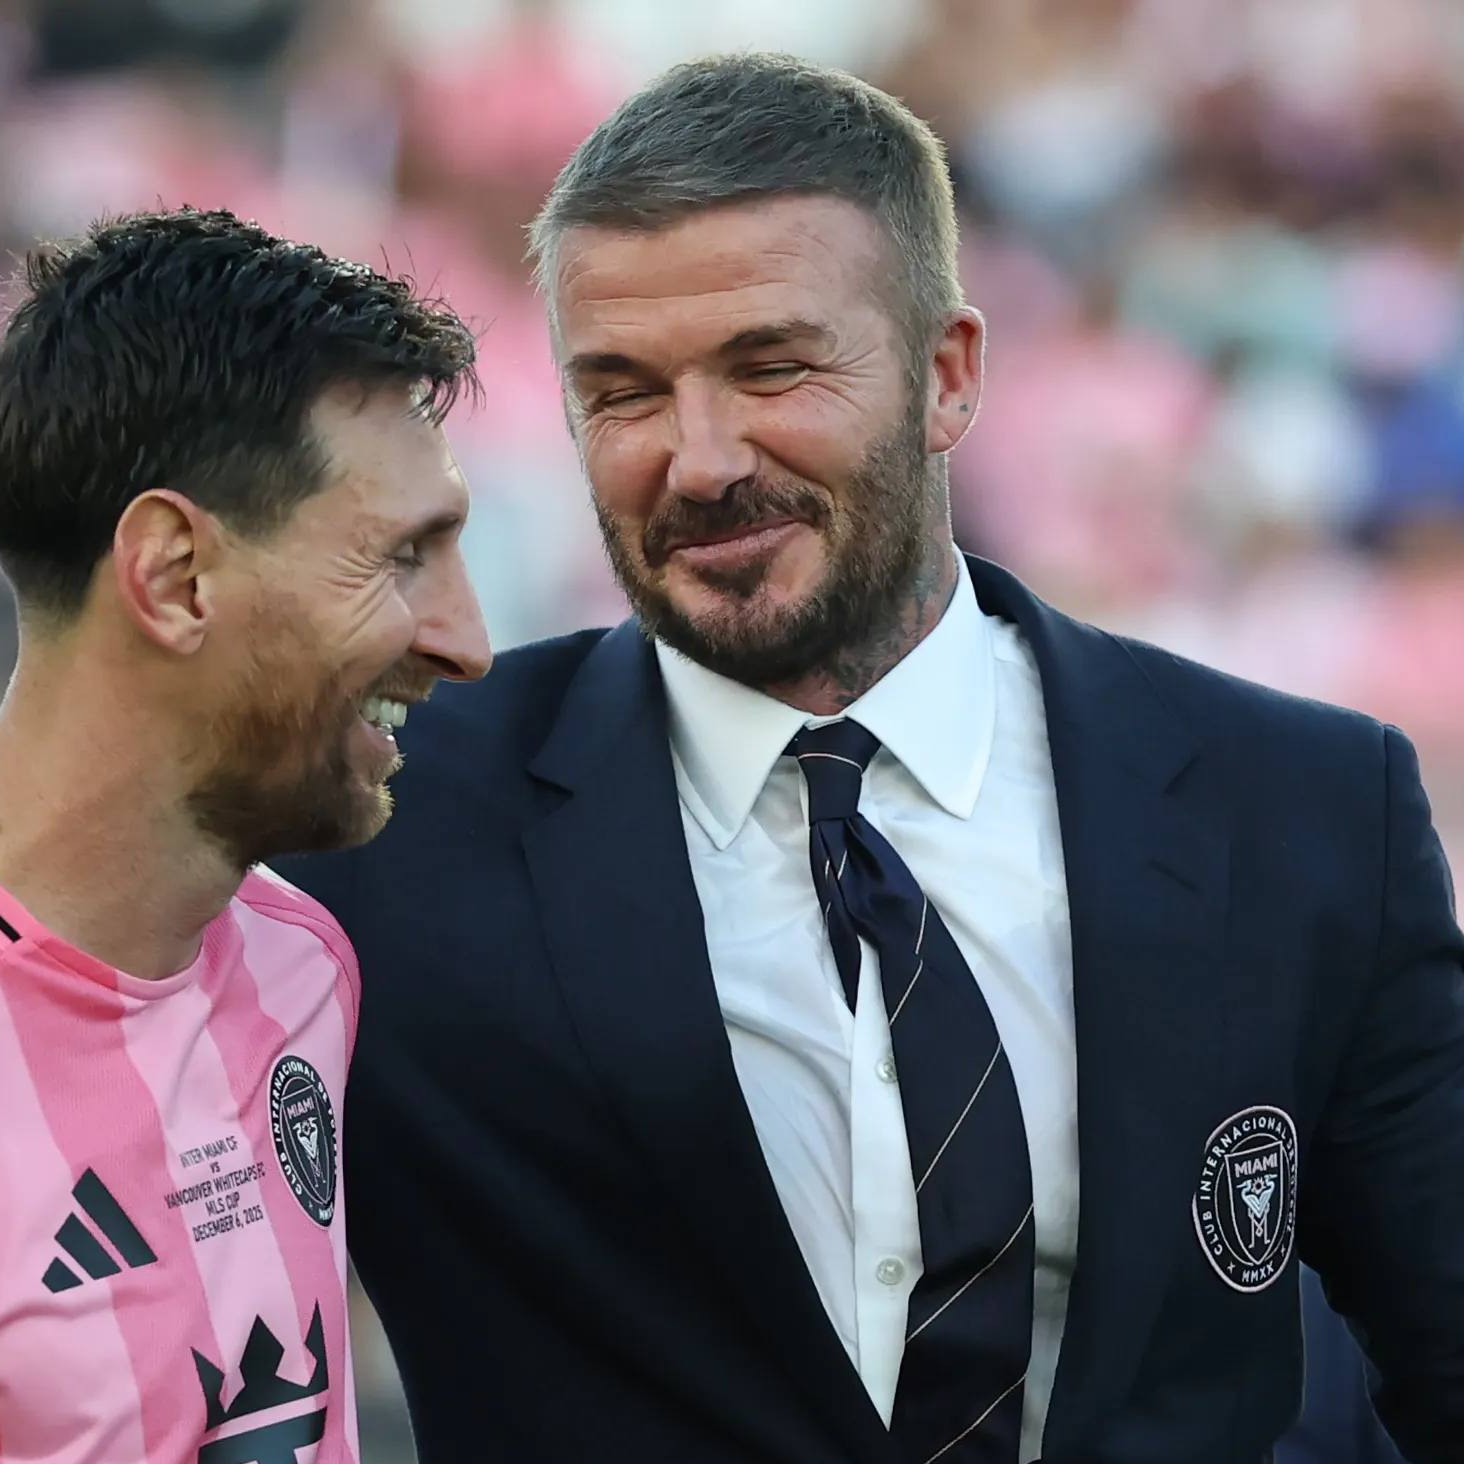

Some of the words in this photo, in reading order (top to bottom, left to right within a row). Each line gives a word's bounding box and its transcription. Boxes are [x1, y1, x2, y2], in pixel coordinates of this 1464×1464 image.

[271, 1060, 317, 1143] INTERNACIONAL
[286, 1096, 316, 1120] MIAMI
[179, 1147, 205, 1169] INTER
[202, 1139, 229, 1159] MIAMI
[225, 1135, 238, 1151] CF
[209, 1161, 221, 1174] VS
[1199, 1116, 1288, 1201] INTERNACIONAL
[1234, 1151, 1279, 1178] MIAMI
[164, 1180, 214, 1210] VANCOUVER
[213, 1165, 257, 1193] WHITECAPS
[280, 1151, 303, 1196] CLUB
[205, 1197, 226, 1217] MLS
[225, 1192, 241, 1211] CUP
[192, 1214, 235, 1243] DECEMBER
[235, 1211, 244, 1229] 6,
[243, 1204, 264, 1225] 2025
[1201, 1210, 1224, 1256] CLUB
[1241, 1259, 1275, 1284] MMXX
